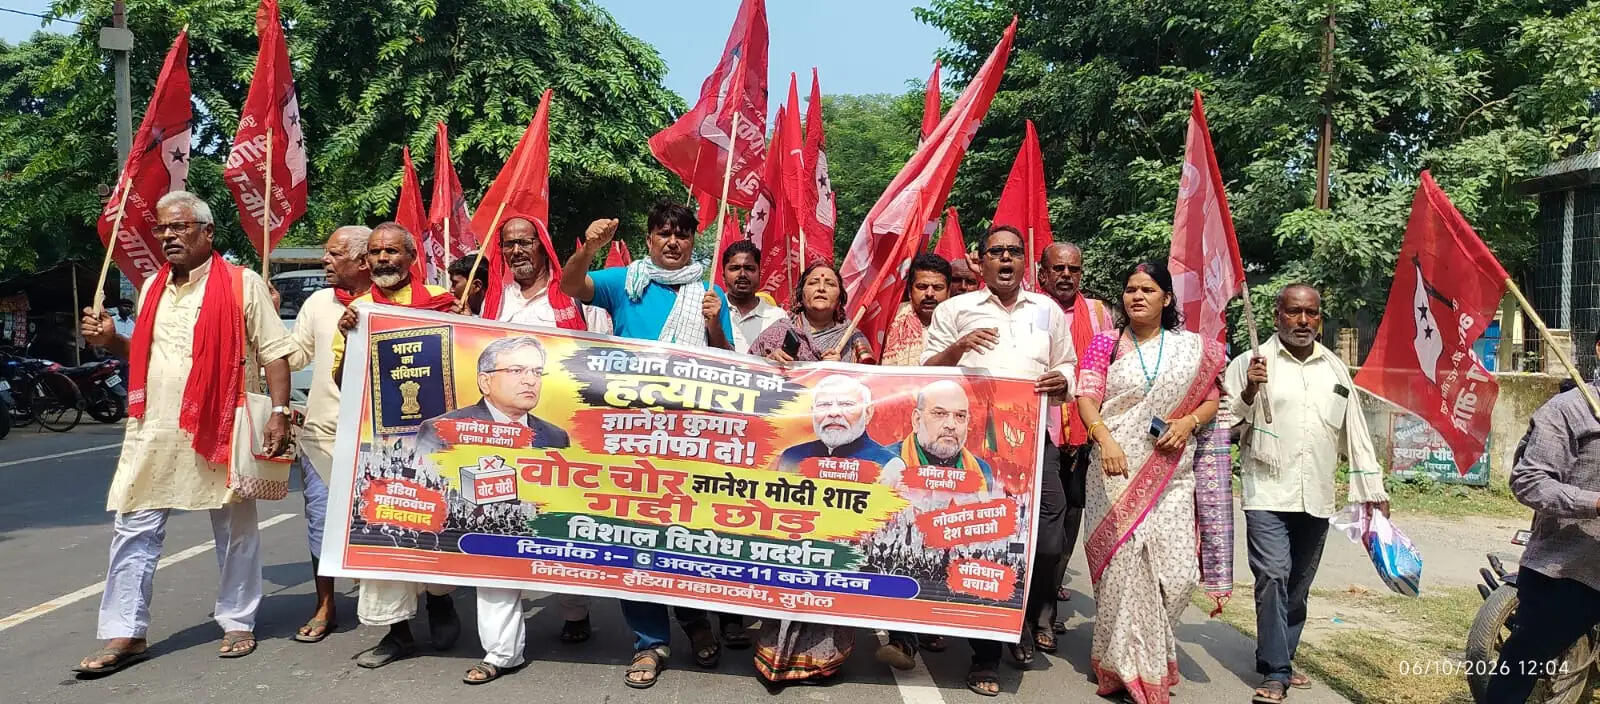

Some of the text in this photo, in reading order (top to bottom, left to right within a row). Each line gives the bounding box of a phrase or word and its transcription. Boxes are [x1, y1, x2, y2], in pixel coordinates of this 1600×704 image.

[392, 341, 423, 354] भारत
[400, 355, 414, 365] का
[586, 350, 669, 375] संविधान
[672, 358, 752, 388] लोकतंत्र
[390, 365, 431, 380] संविधान
[603, 373, 761, 413] हत्यारा
[492, 424, 521, 437] कुमार
[602, 409, 748, 437] ज्ञानेश कुमार
[602, 429, 756, 465] इस्तीफा दो!
[838, 459, 859, 471] मोदी
[917, 466, 967, 482] अमित शाह
[386, 481, 417, 497] इंडिया
[477, 478, 514, 496] वोट चोरी
[516, 450, 871, 515] वोट चोर ज्ञानेश मोदी शाह
[711, 499, 821, 540] छोड़
[933, 508, 975, 527] लोकतंत्र
[567, 515, 835, 567] विशाल विरोध प्रदर्शन
[943, 526, 962, 541] देश
[516, 539, 600, 560] दिनांक
[636, 552, 651, 564] 6
[748, 566, 773, 581] 11
[777, 570, 820, 586] बजे
[823, 573, 872, 590] दिन
[958, 562, 1005, 580] संविधान
[622, 569, 675, 589] इंडिया
